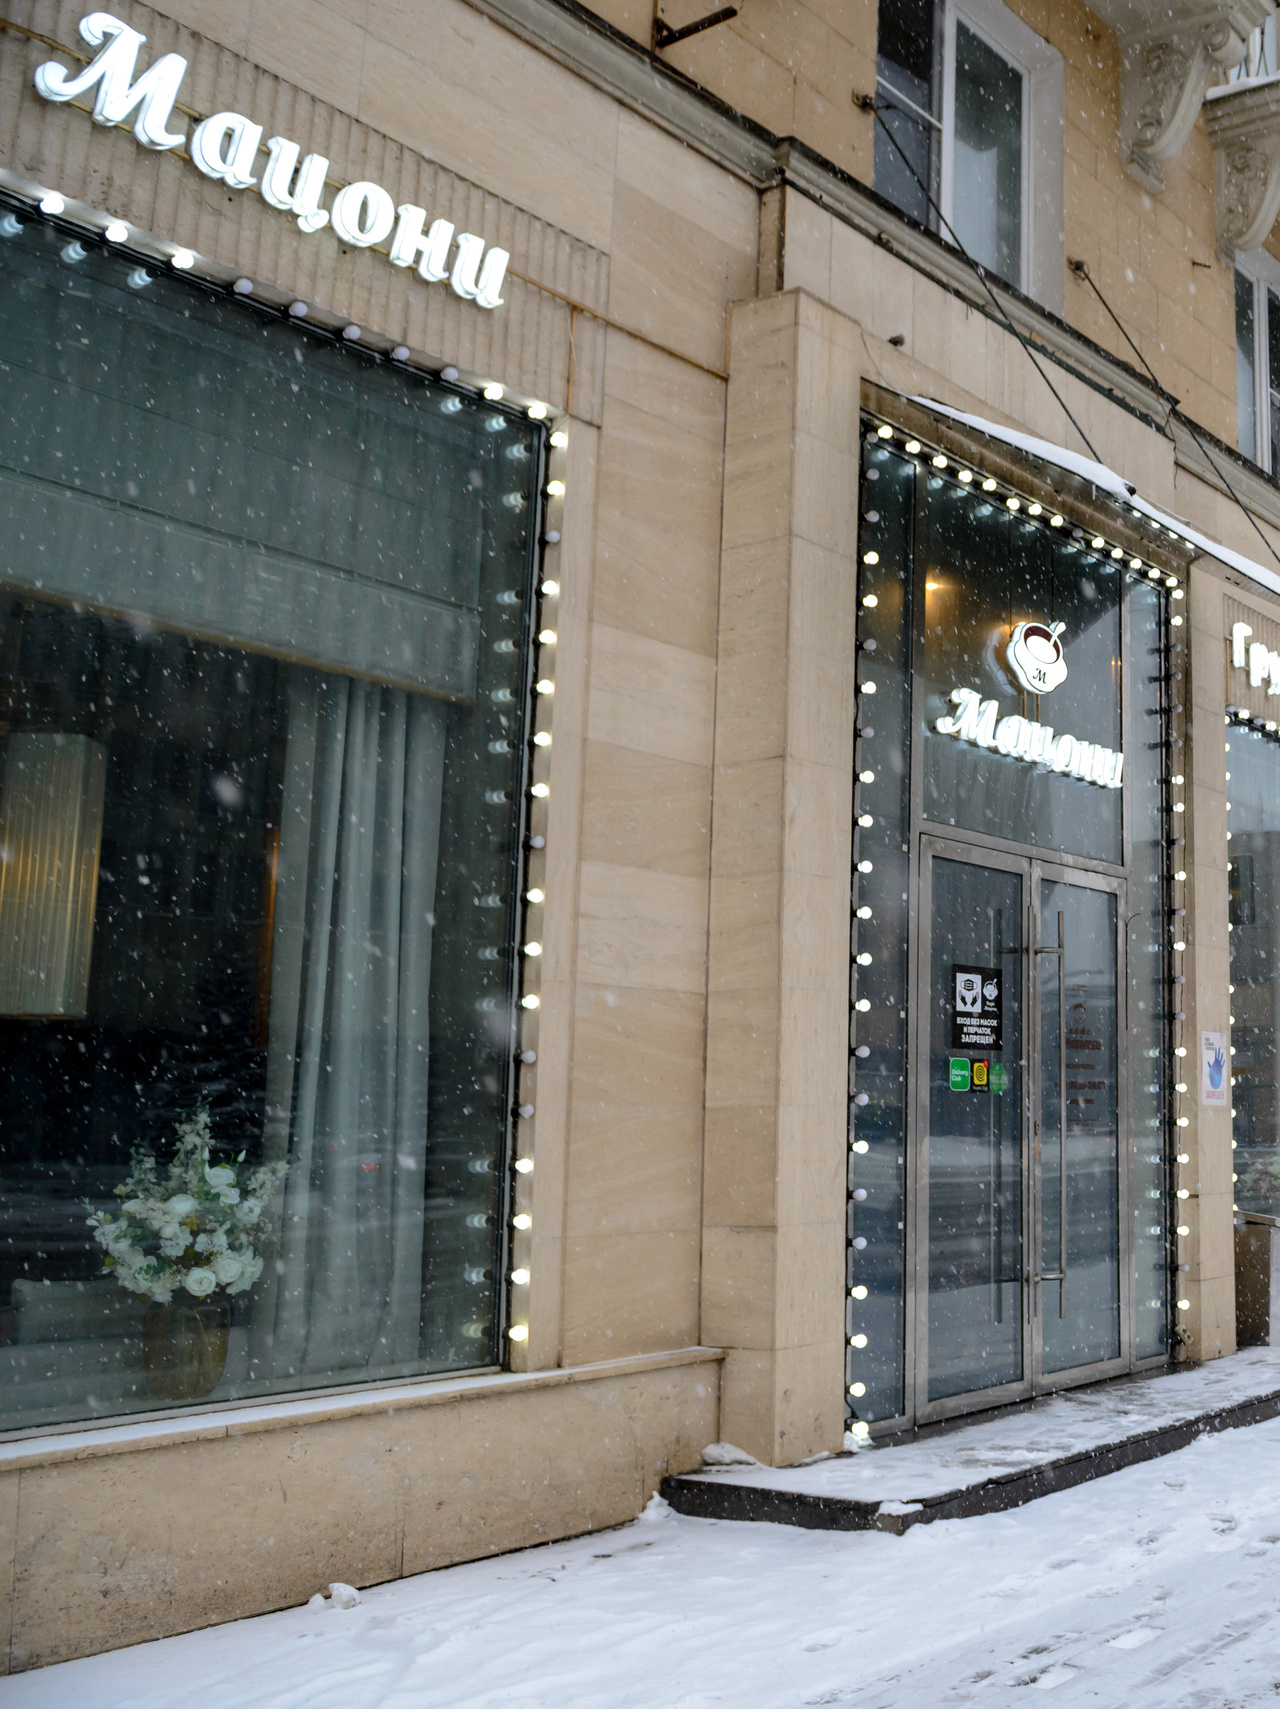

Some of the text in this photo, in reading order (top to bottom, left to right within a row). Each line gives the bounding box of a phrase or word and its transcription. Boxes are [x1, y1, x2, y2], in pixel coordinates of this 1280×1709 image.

[34, 12, 510, 309] Мацони
[936, 687, 1124, 788] Мацони
[957, 1017, 970, 1025] ВХОД
[971, 1018, 980, 1026] БЕЗ
[968, 1026, 991, 1035] ПЕРЧАТОК
[961, 1034, 993, 1044] ЗАПРЕЩЕН
